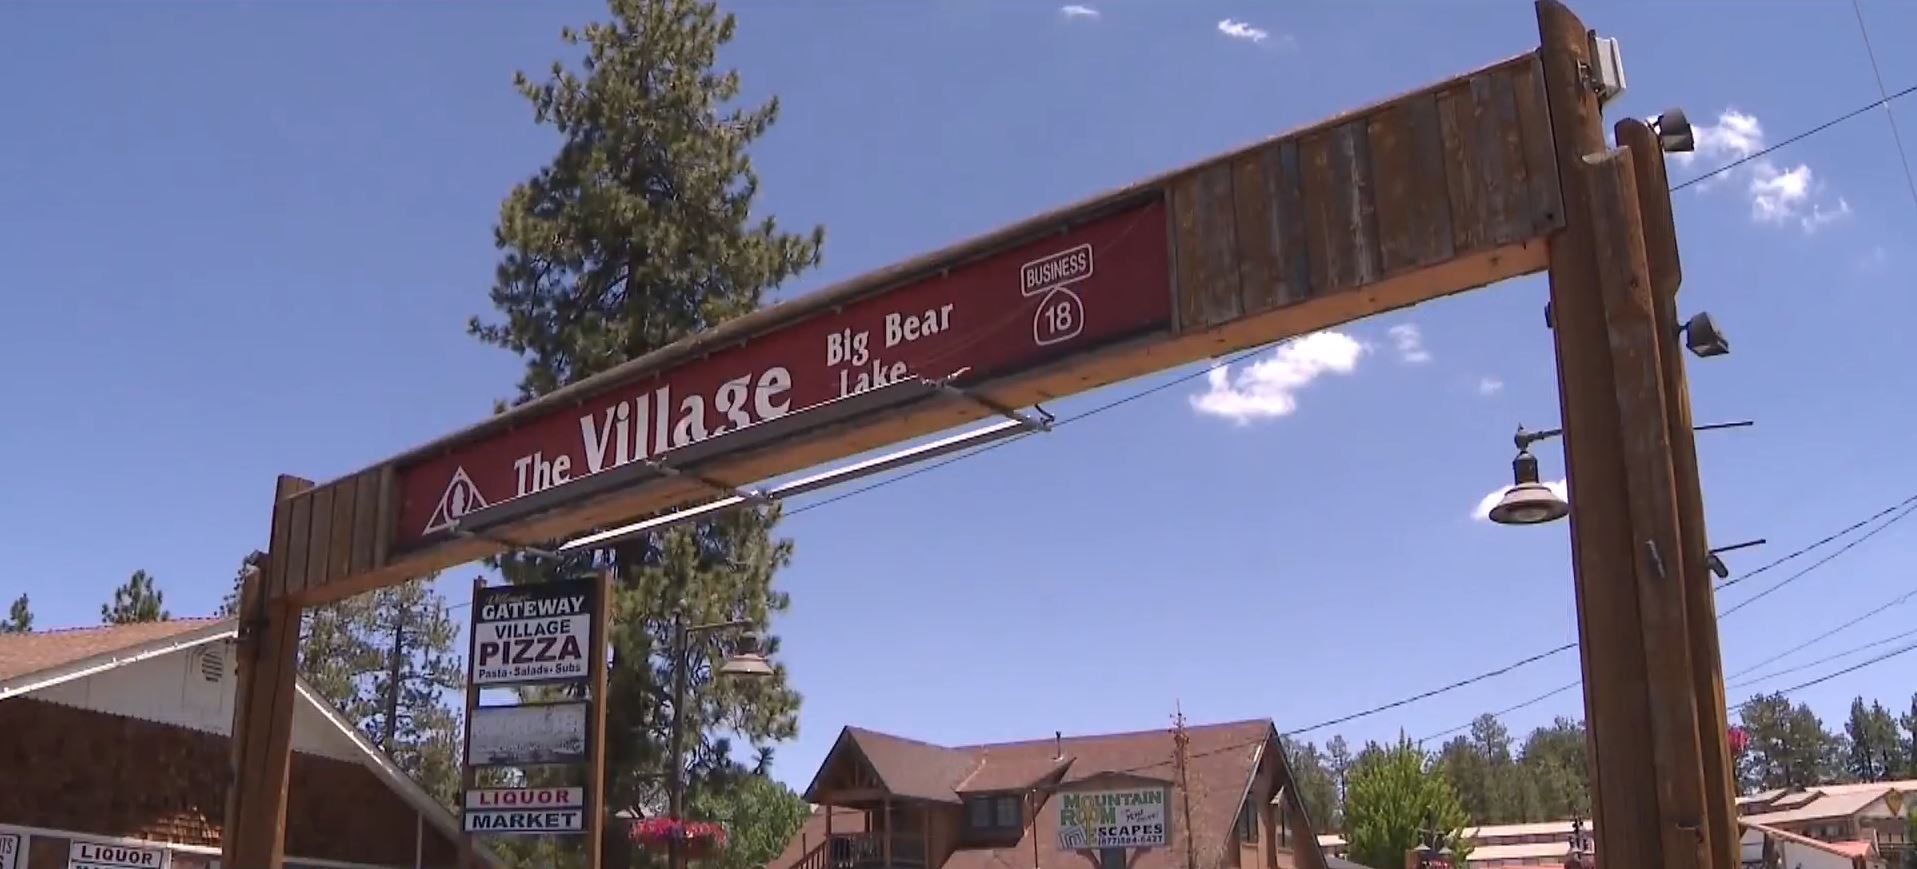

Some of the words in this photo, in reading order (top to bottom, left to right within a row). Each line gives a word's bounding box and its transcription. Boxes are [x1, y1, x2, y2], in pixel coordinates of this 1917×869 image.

[1026, 252, 1088, 288] BUSINESS
[1045, 301, 1072, 334] 18
[827, 327, 869, 367] Big
[885, 303, 953, 348] Bear
[839, 359, 907, 398] Lake
[513, 450, 572, 498] The
[579, 366, 792, 474] Village
[482, 596, 584, 620] GATEWAY
[495, 619, 571, 640] VILLAGE
[479, 635, 582, 667] PIZZA
[480, 790, 569, 806] LIQUOR
[1063, 791, 1162, 809] MOUNTAIN
[472, 812, 577, 829] MARKET
[81, 845, 153, 865] LIQUOR
